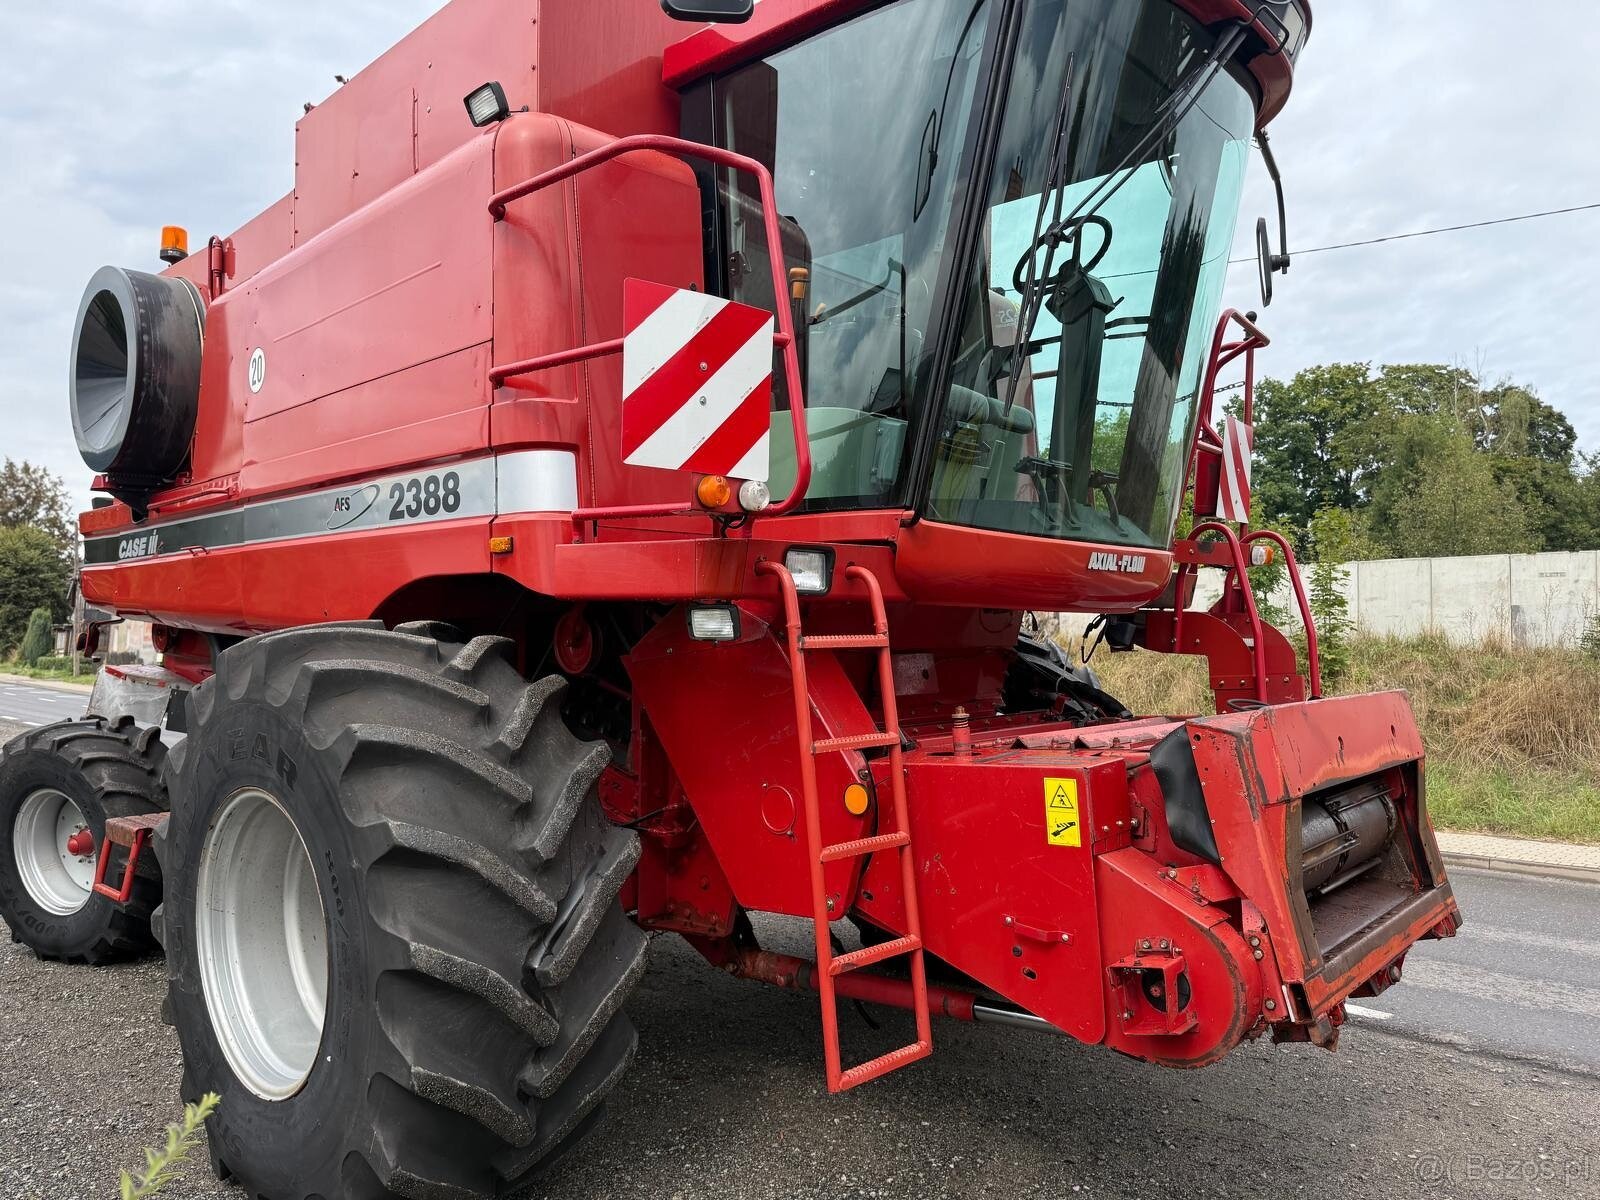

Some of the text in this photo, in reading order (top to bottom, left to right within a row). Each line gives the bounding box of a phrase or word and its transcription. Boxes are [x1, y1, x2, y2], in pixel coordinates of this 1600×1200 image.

[251, 355, 262, 386] 20
[334, 496, 351, 512] AFS
[388, 471, 461, 521] 2388
[118, 537, 148, 559] CASE
[1088, 551, 1146, 573] AXIAL-FLOW
